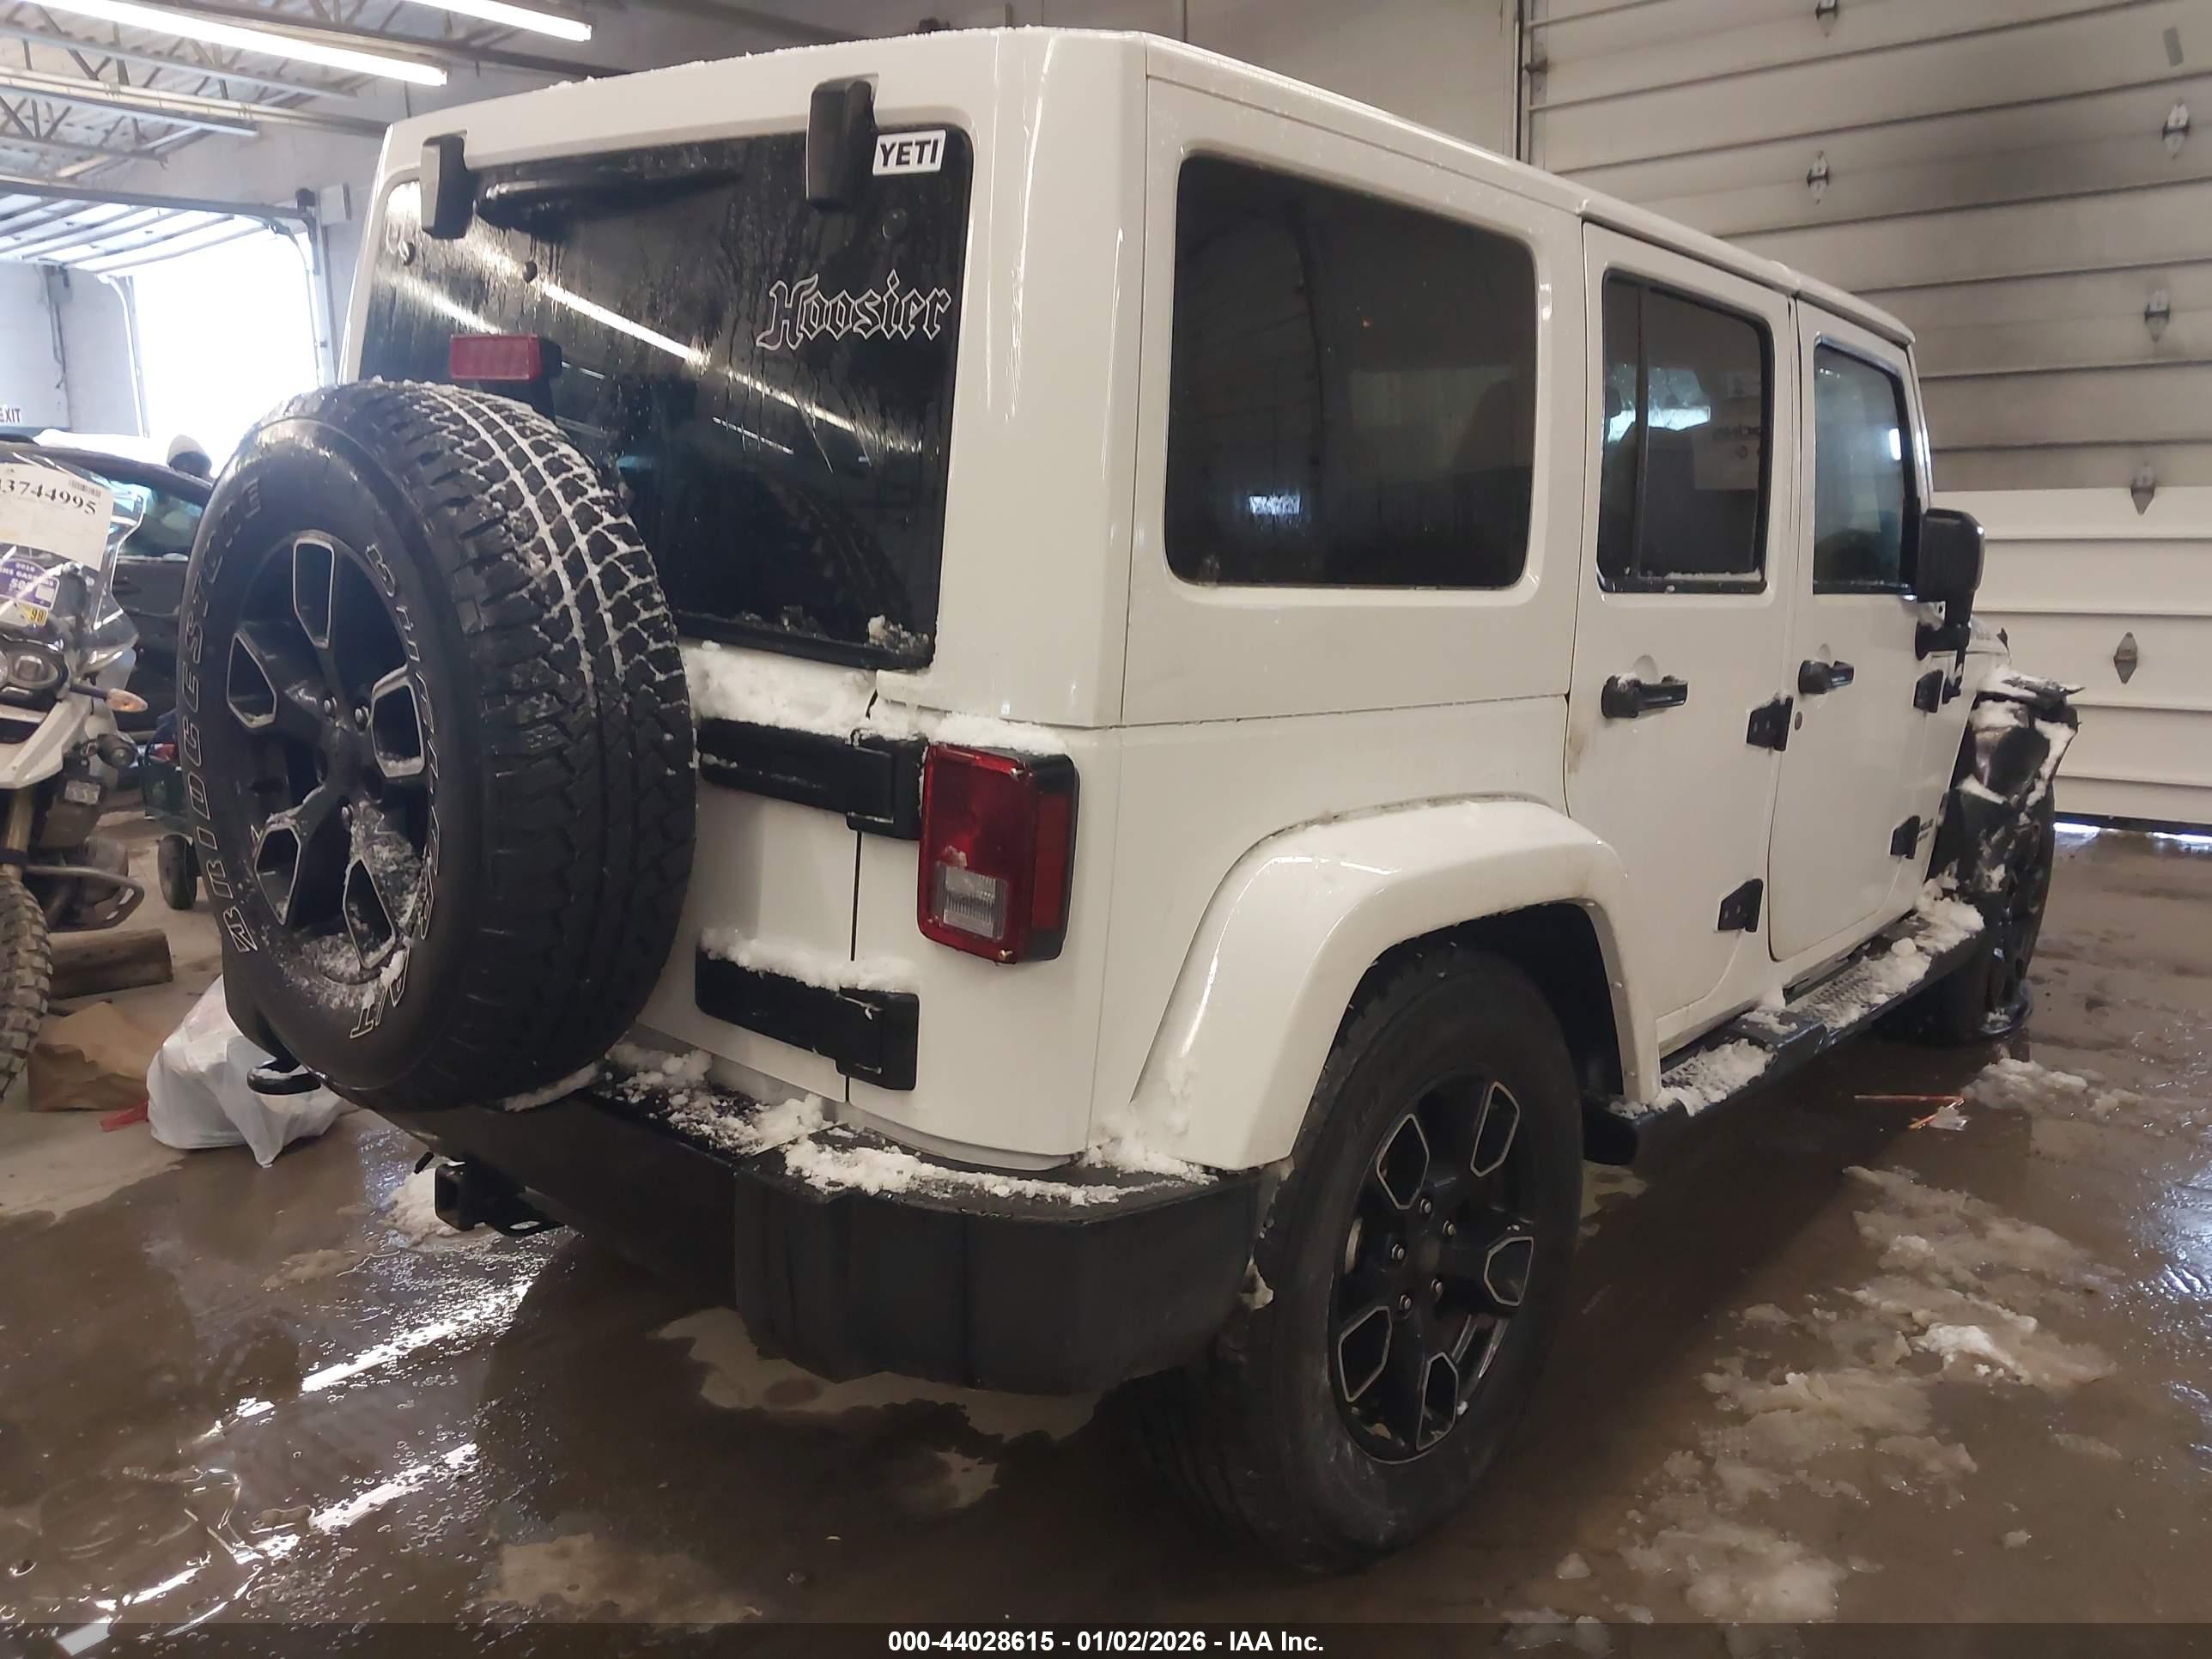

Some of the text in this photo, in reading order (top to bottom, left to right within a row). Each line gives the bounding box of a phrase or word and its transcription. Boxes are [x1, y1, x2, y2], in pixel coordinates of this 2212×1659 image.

[880, 138, 940, 167] YETI
[756, 268, 951, 351] Hoosier
[180, 477, 262, 954] BRIDGESTONE
